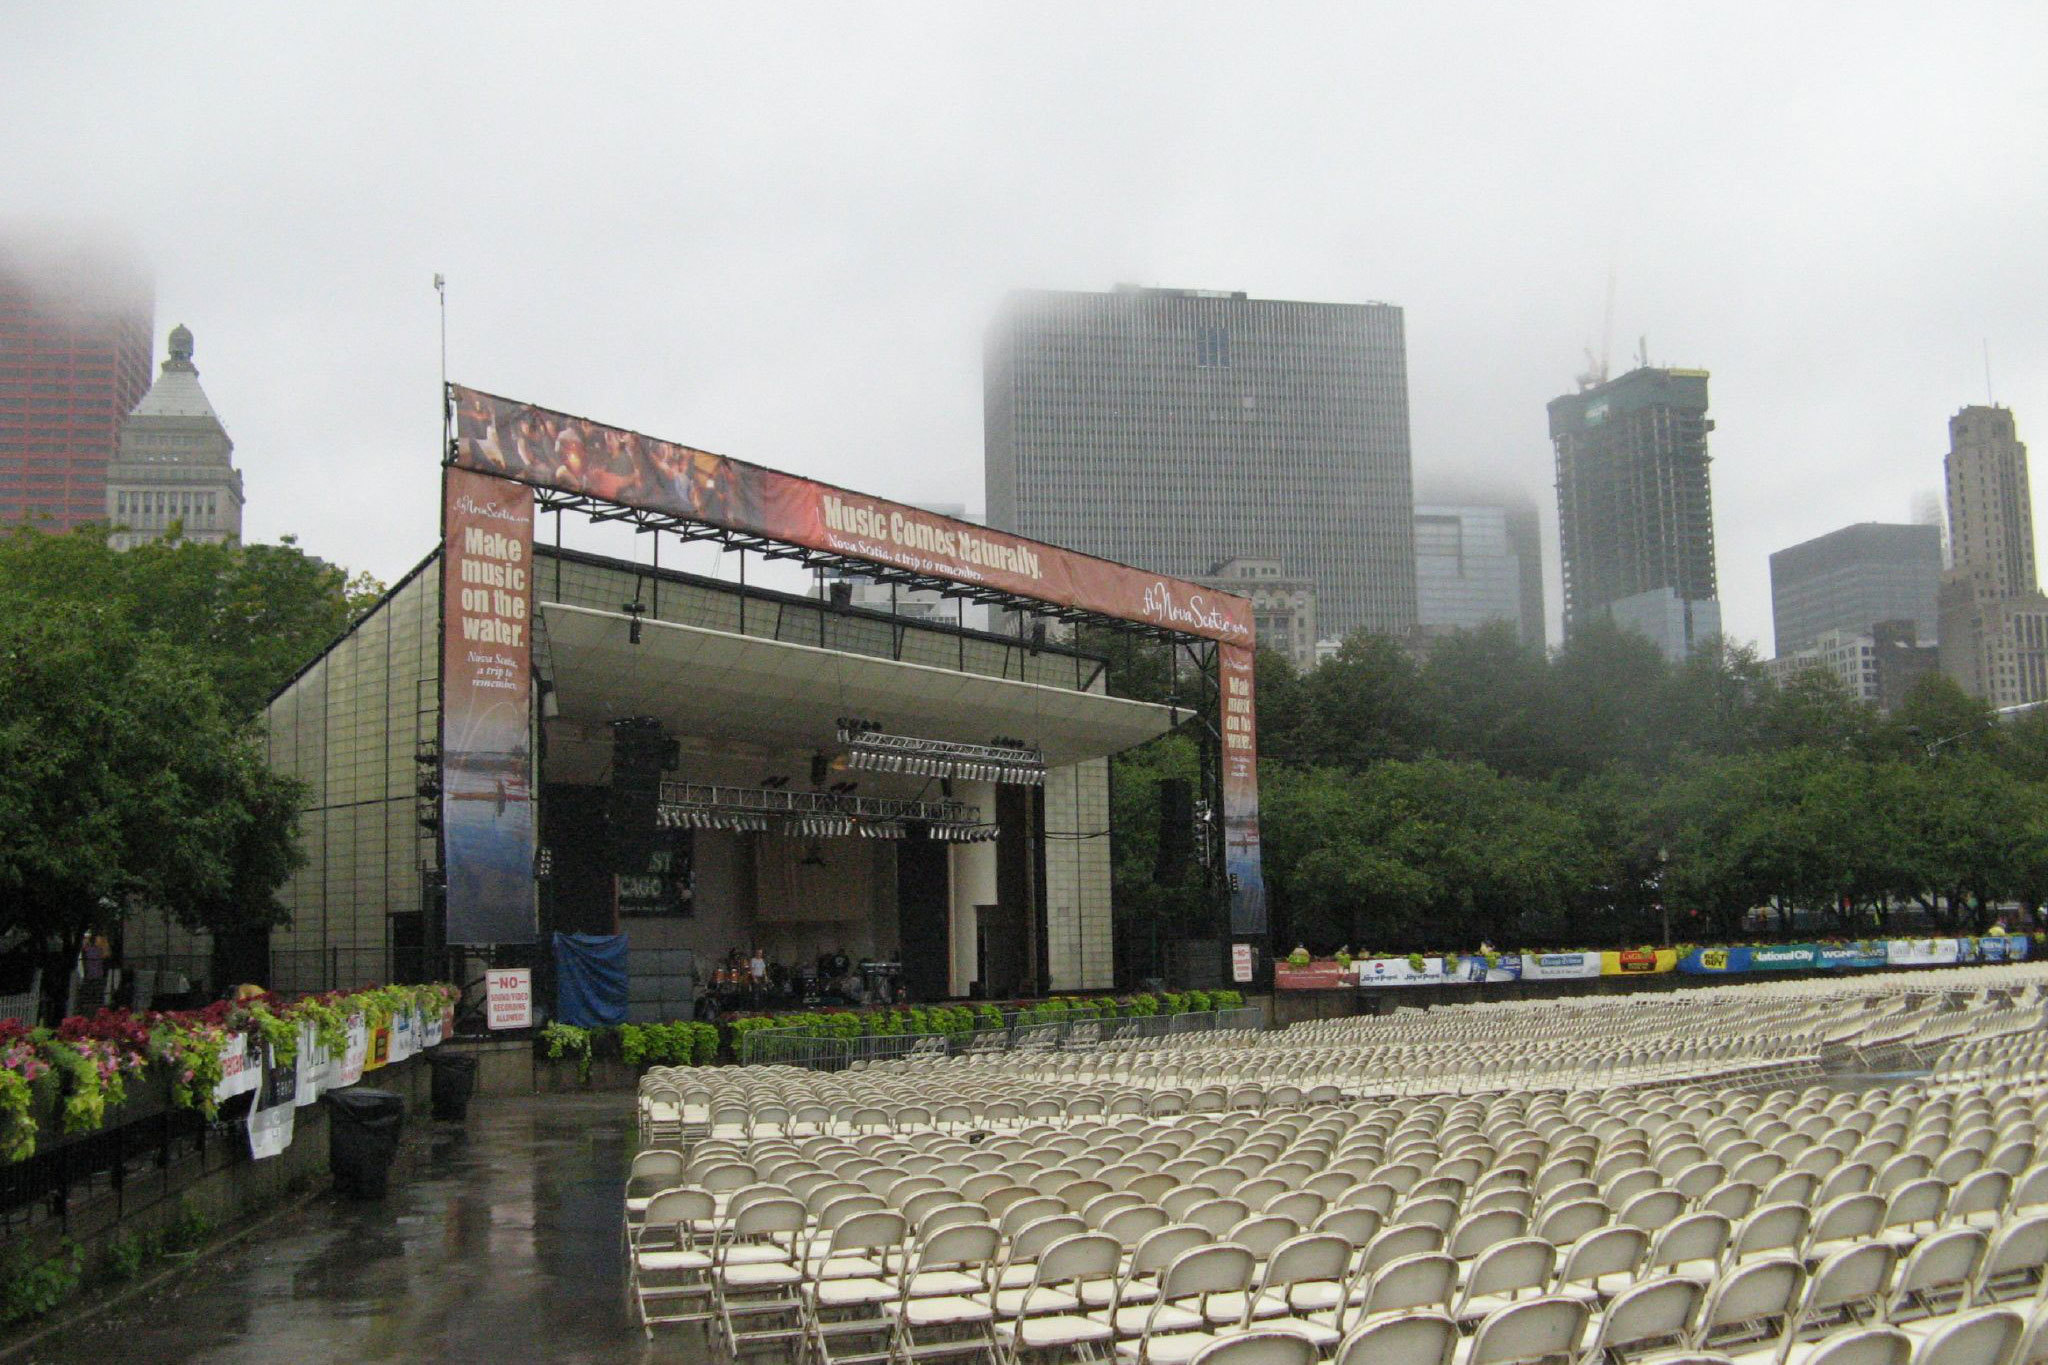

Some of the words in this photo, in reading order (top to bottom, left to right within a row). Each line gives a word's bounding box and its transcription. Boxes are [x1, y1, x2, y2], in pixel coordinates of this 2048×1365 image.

[465, 526, 522, 562] Make
[823, 494, 888, 540] Music
[890, 512, 956, 557] Comes
[958, 530, 1043, 580] Naturally.
[828, 532, 857, 551] Nova
[902, 553, 920, 572] trip
[922, 558, 933, 571] to
[462, 558, 525, 590] music
[462, 588, 489, 612] on
[494, 588, 526, 619] the
[462, 616, 524, 647] water.
[1228, 676, 1249, 696] Mak
[1794, 950, 1814, 962] City
[499, 976, 518, 988] NO
